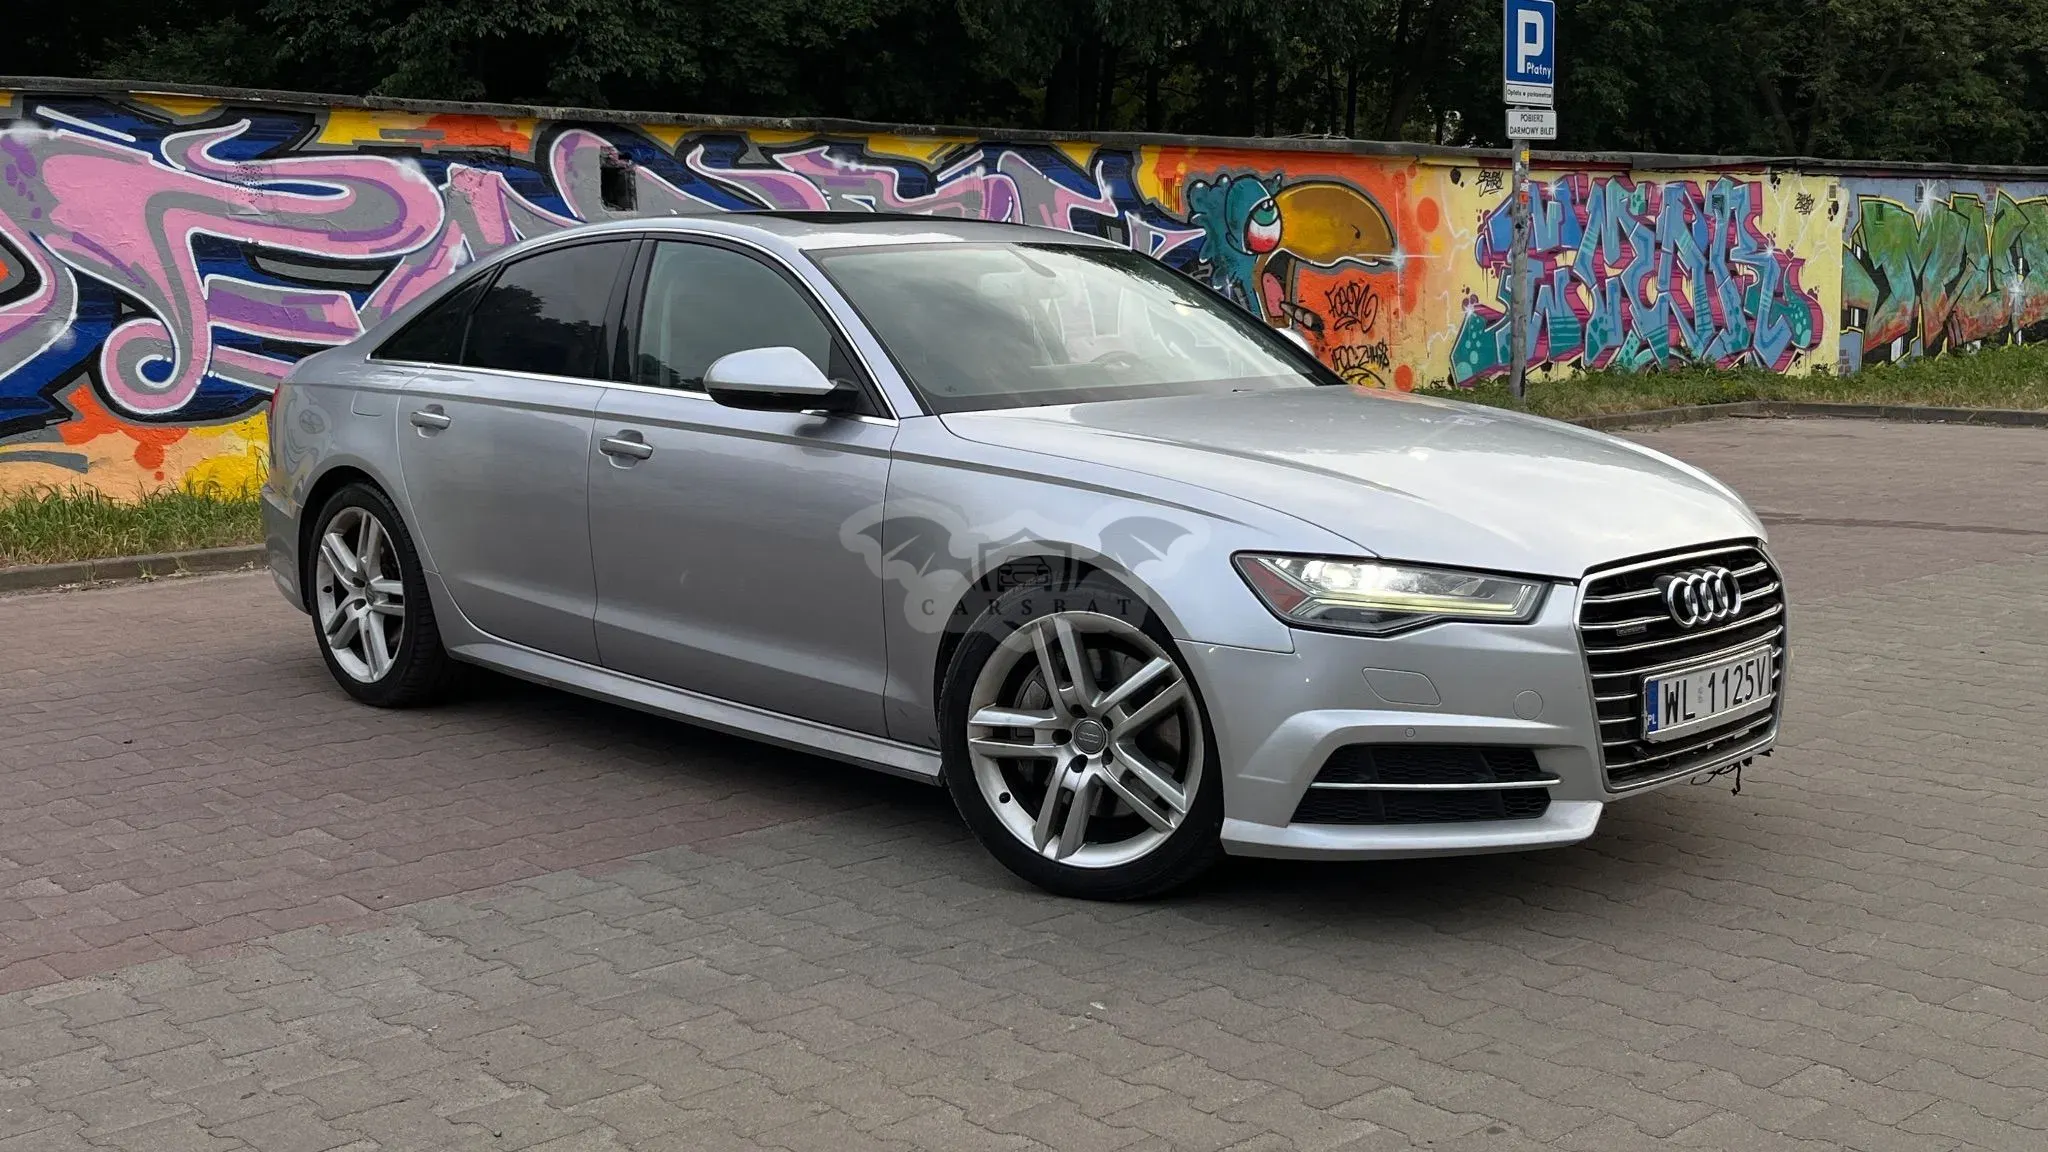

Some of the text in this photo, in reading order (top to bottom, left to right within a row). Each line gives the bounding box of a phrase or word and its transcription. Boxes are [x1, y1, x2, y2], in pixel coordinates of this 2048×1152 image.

[1517, 9, 1544, 73] P
[1526, 62, 1551, 79] Płatny
[1520, 113, 1544, 122] POBIERZ
[1510, 126, 1554, 135] DARMOWY BILET
[1664, 679, 1696, 725] WL
[1707, 655, 1767, 714] 1125V
[1648, 713, 1657, 726] PL
